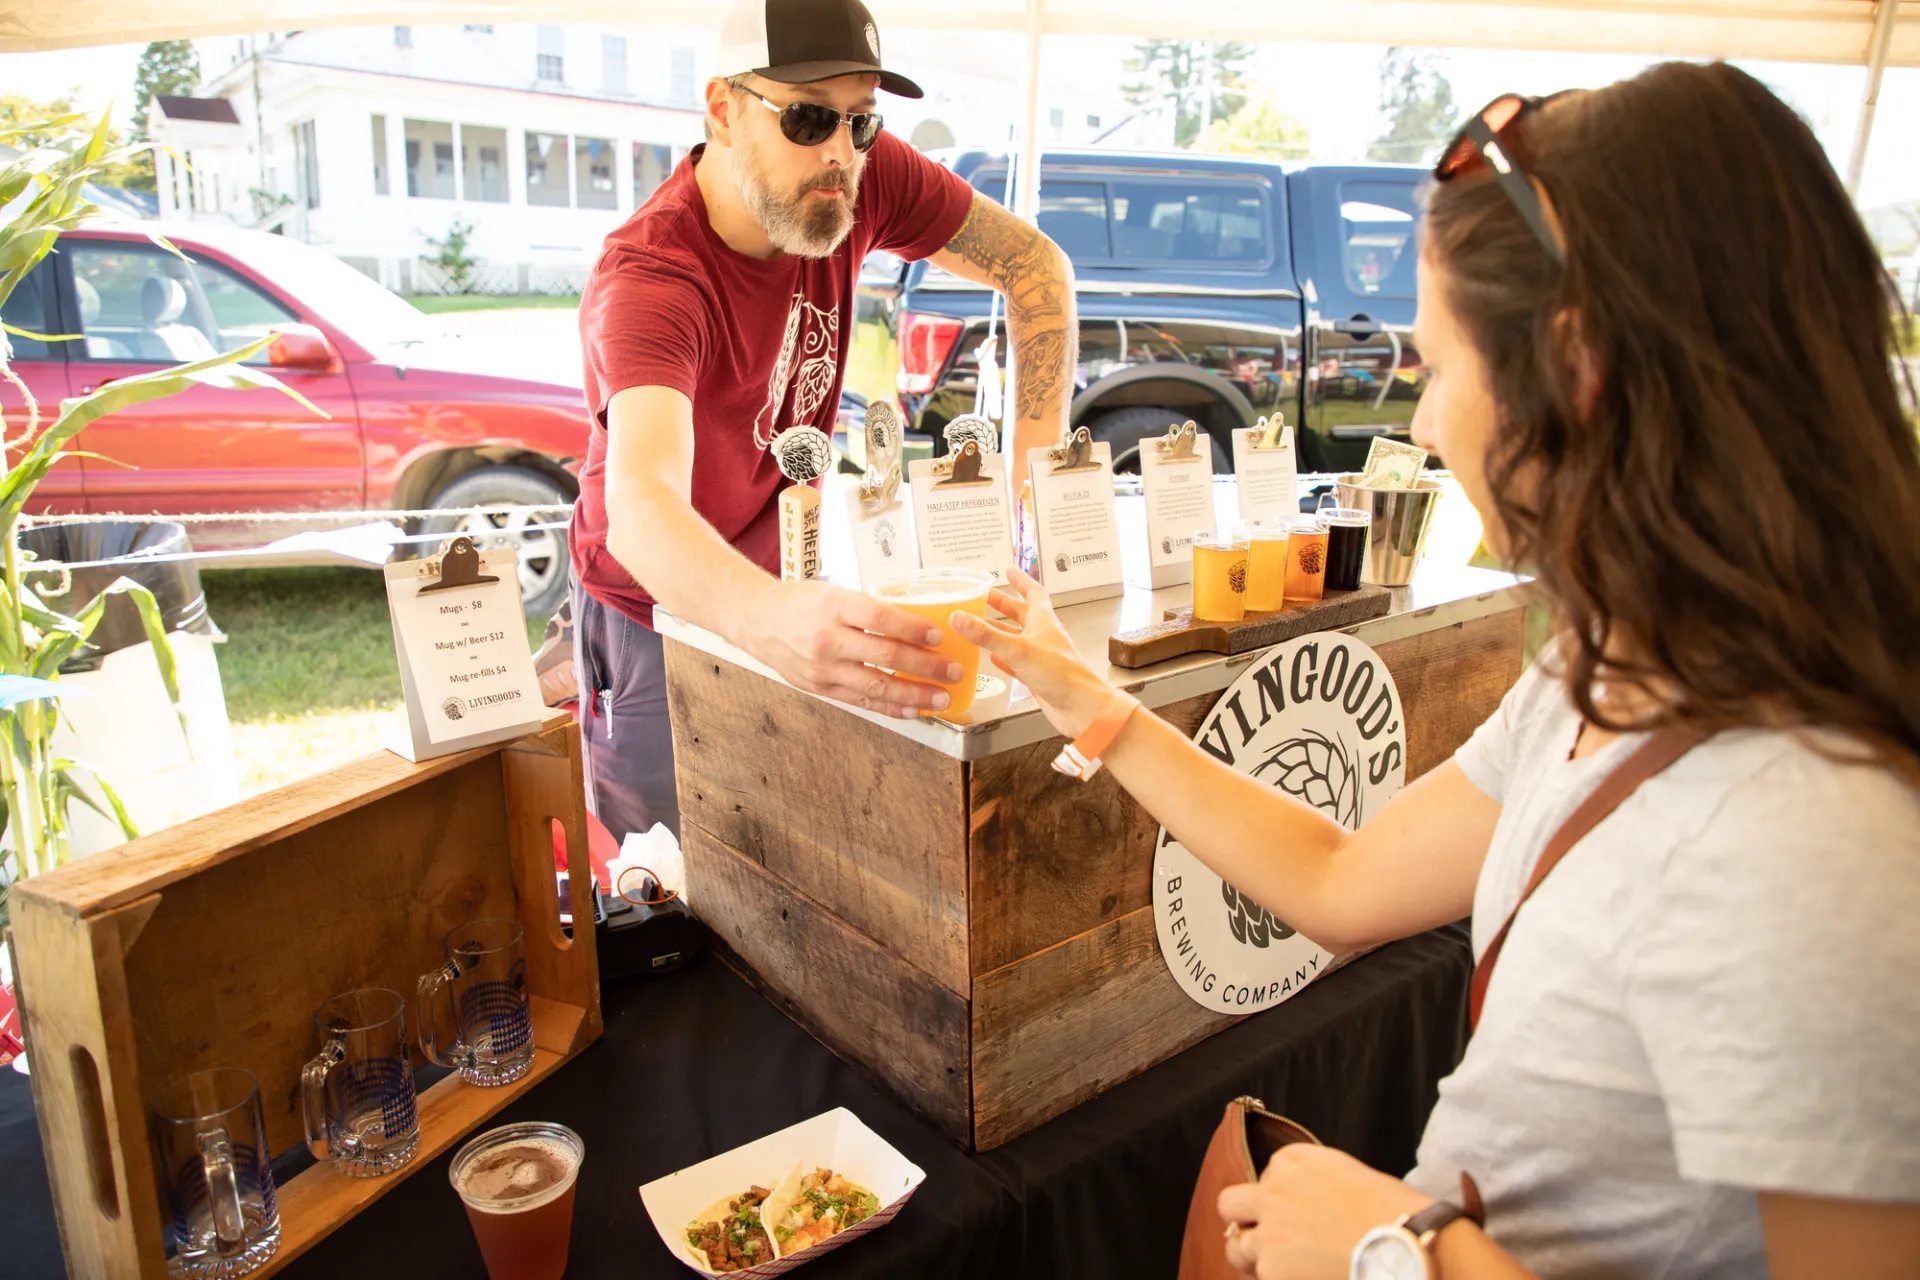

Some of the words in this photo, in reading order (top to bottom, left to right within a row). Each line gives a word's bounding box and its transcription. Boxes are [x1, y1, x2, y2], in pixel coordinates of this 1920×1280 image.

[803, 505, 819, 519] HALF
[927, 500, 960, 511] HALF-STEP
[804, 514, 820, 529] STEP
[440, 603, 463, 615] Mugs
[471, 600, 483, 610] $8
[435, 640, 455, 650] Mug
[456, 637, 467, 648] w/
[469, 635, 488, 645] Beer
[489, 631, 505, 642] $12
[449, 673, 470, 683] Mug
[470, 668, 496, 679] re-fills
[496, 665, 507, 675] $4
[469, 690, 521, 708] LIVINGOOD'S
[1167, 876, 1217, 993] BREWING
[1222, 954, 1319, 1005] COMPANY
